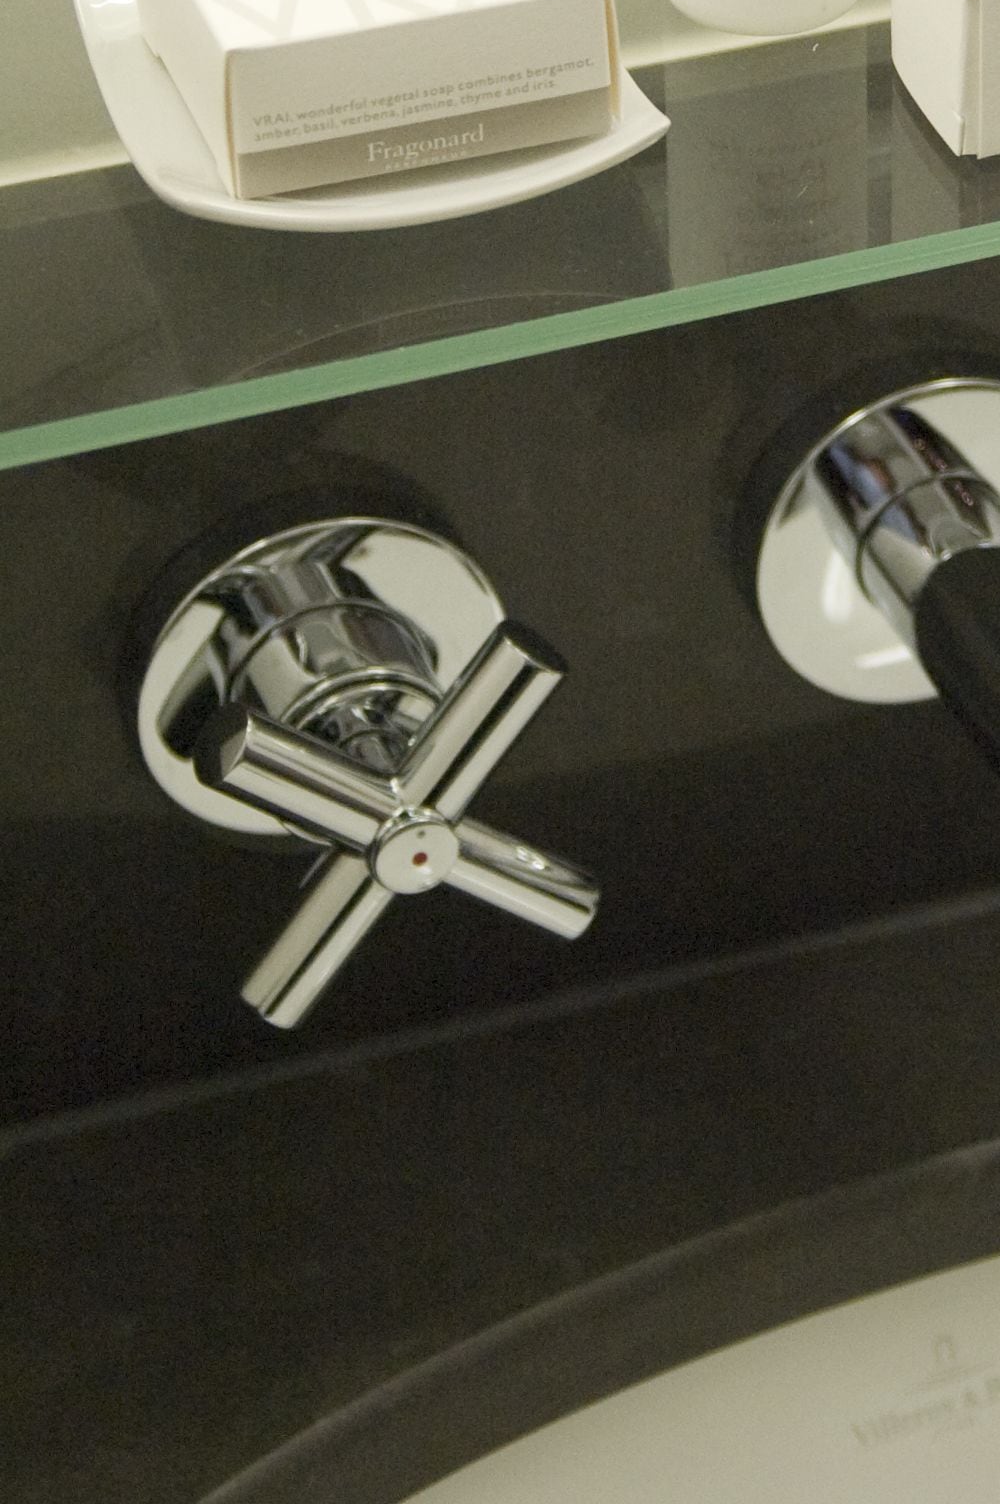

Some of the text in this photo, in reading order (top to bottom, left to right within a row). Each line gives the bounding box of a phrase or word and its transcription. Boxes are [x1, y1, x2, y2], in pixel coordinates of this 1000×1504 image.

[296, 99, 368, 120] wonderful
[422, 84, 454, 98] soap
[457, 71, 523, 91] combines
[460, 88, 501, 107] thyme
[504, 81, 530, 95] and
[367, 123, 485, 163] Fragonard
